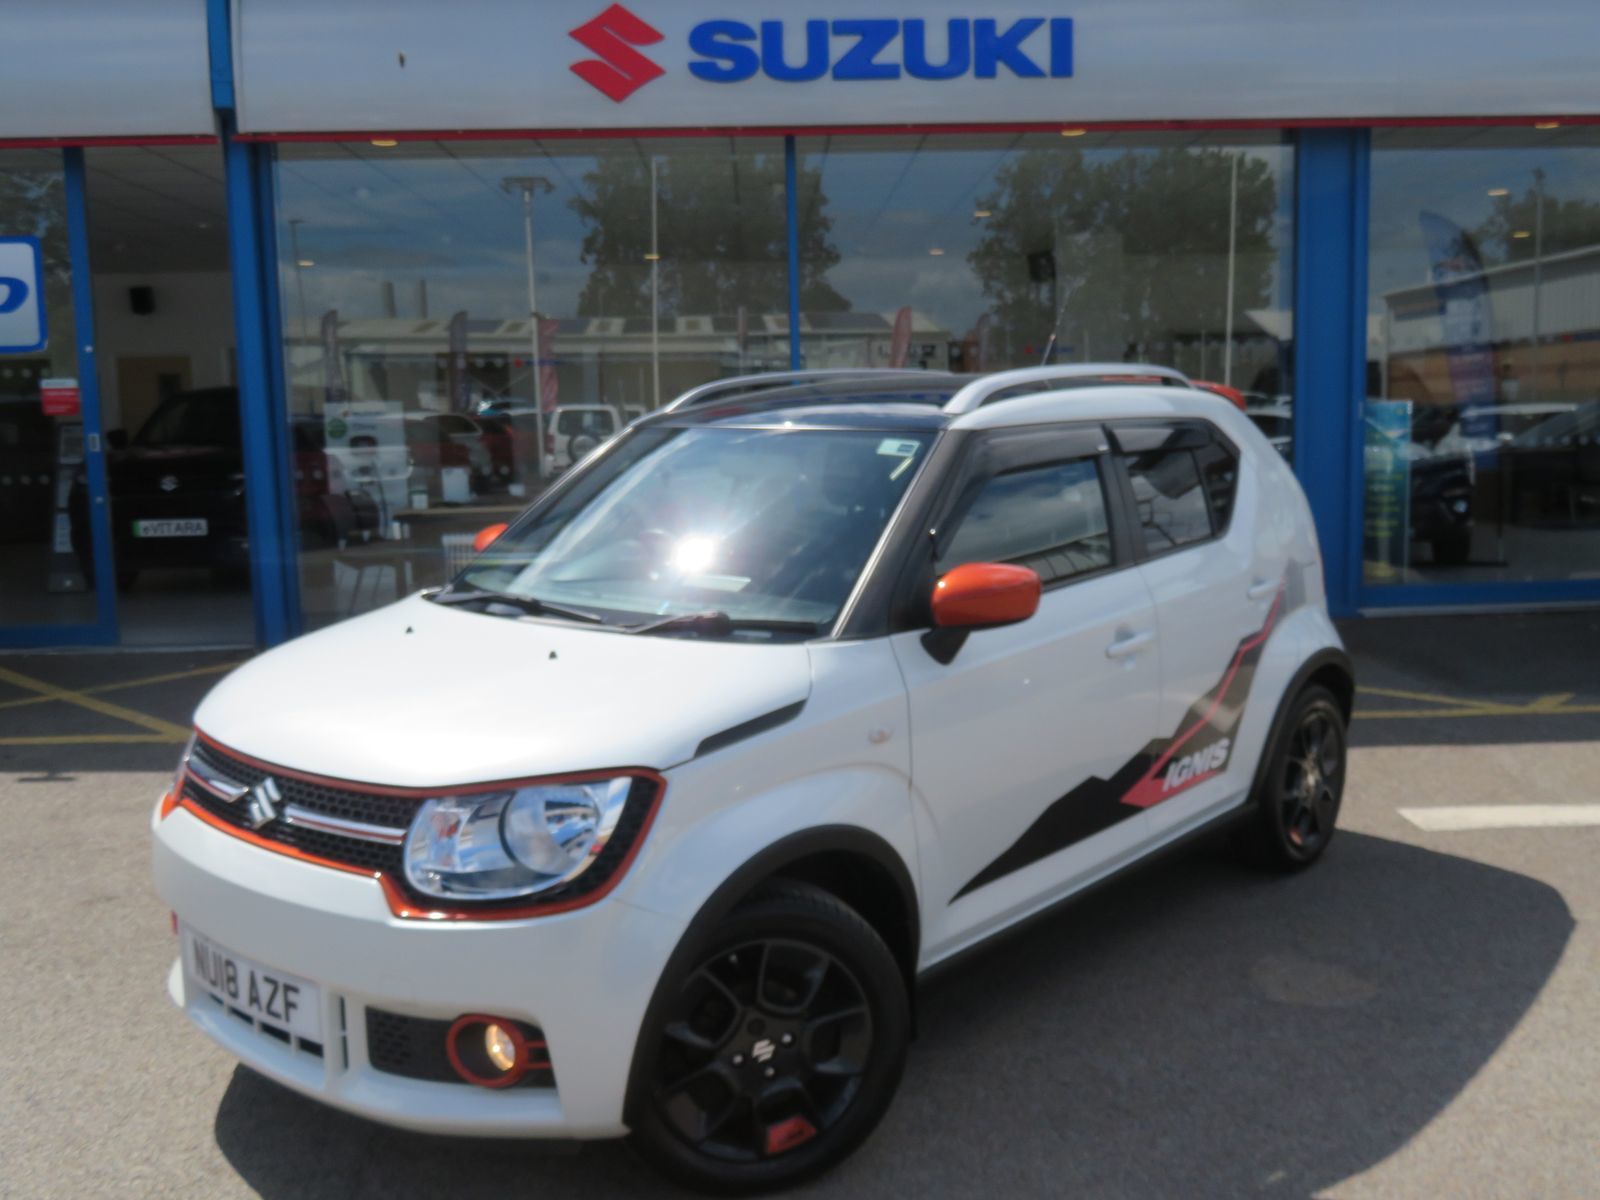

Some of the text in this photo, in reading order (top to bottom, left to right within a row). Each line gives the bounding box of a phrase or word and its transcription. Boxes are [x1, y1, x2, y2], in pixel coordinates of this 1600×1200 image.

[688, 18, 1074, 83] SUZUKI
[1162, 738, 1230, 792] IGNIS
[193, 938, 300, 1022] NU18 AZF
